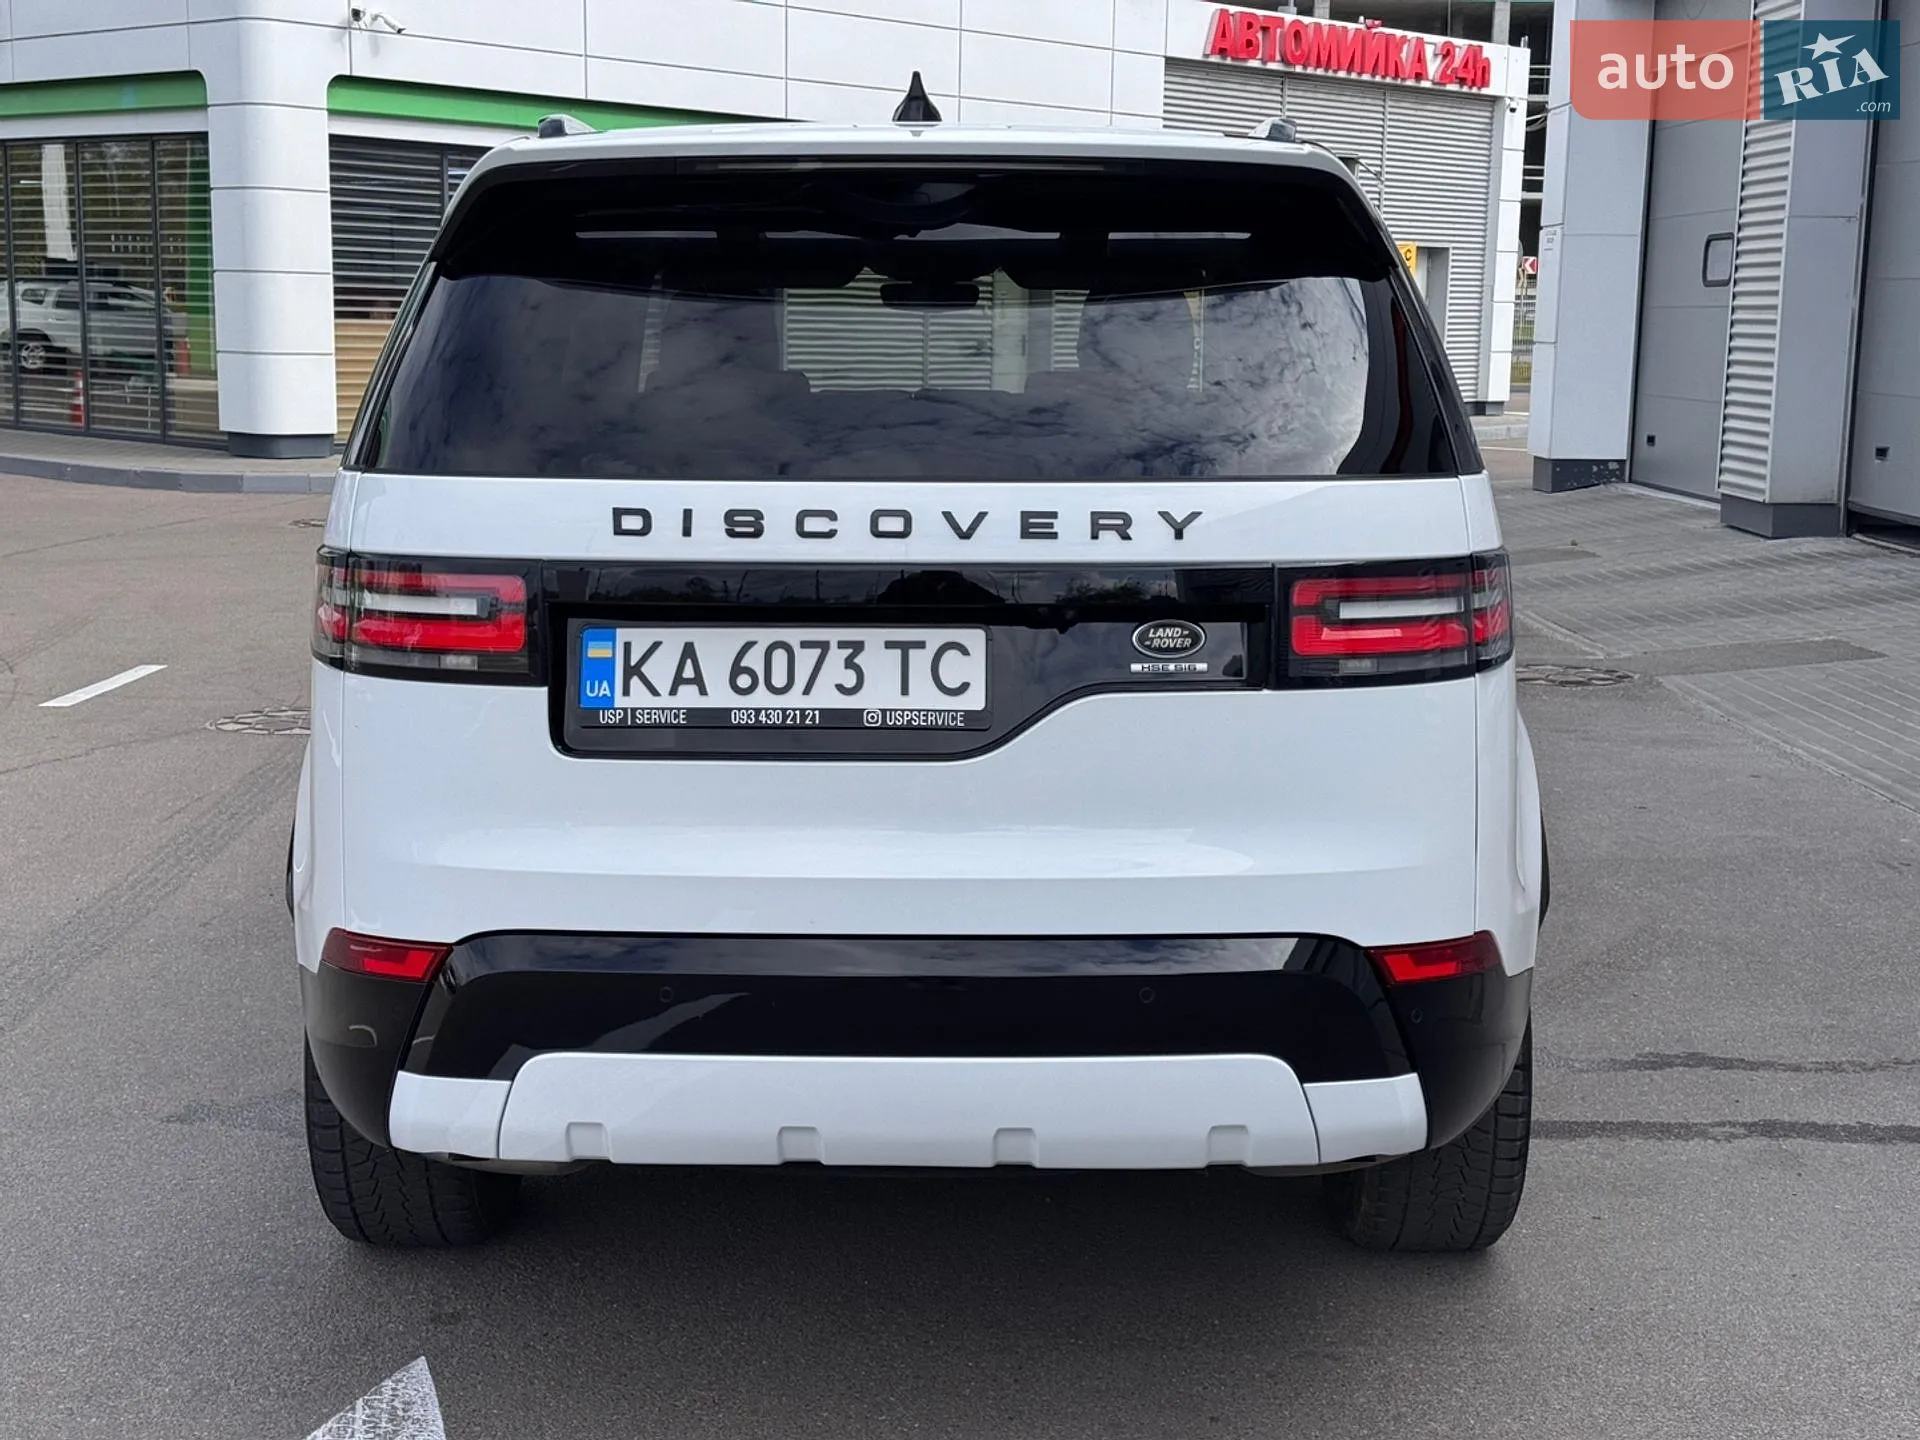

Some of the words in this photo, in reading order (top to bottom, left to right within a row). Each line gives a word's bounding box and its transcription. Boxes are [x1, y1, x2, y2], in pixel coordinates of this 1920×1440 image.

[1203, 8, 1429, 81] АВТОМИЙКА
[1432, 40, 1491, 89] 24h
[611, 506, 1204, 541] DISCOVERY
[621, 640, 709, 697] KA
[728, 640, 866, 697] 6073
[883, 640, 972, 697] TC
[1141, 663, 1171, 673] HSE
[586, 680, 612, 698] UA
[599, 709, 624, 724] USP
[635, 709, 688, 724] SERVICE
[730, 709, 756, 725] 093
[758, 709, 784, 725] 430
[786, 709, 801, 725] 21
[804, 709, 820, 725] 21
[886, 710, 966, 727] USPSERVICE
